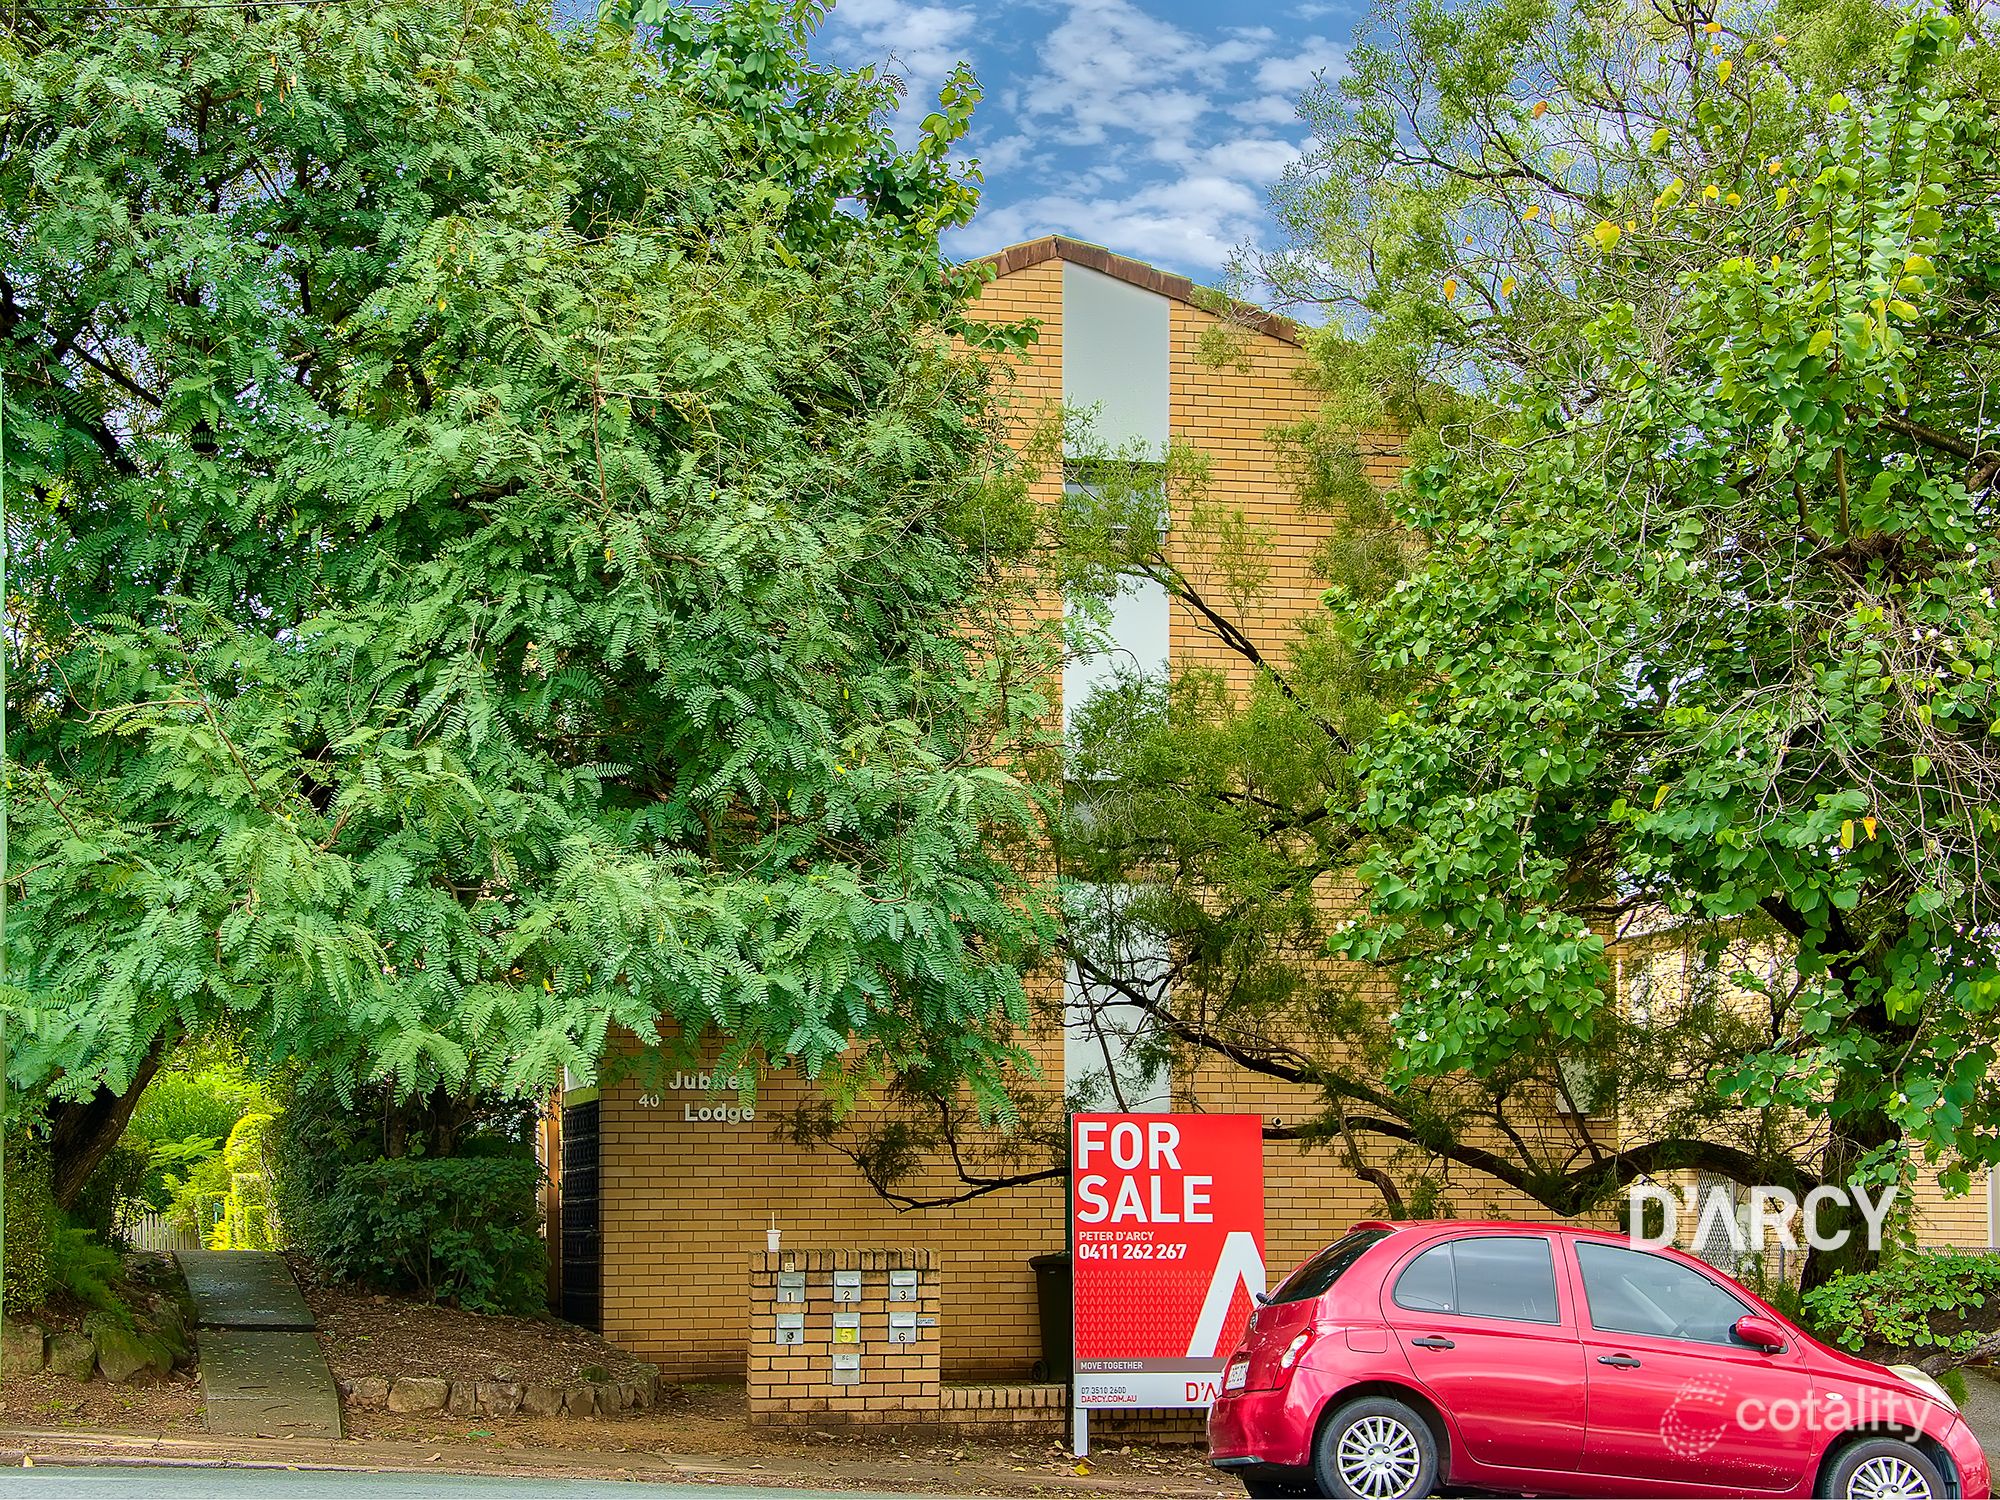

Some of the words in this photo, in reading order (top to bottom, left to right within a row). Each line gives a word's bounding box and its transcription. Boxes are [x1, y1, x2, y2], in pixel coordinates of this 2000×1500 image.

[638, 1093, 660, 1107] 40
[684, 1103, 755, 1125] Lodge
[1078, 1122, 1182, 1170] FOR
[1077, 1175, 1214, 1223] SALE
[1079, 1231, 1114, 1241] PETER
[1115, 1231, 1155, 1241] D'ARCY
[1079, 1243, 1118, 1260] 0411
[1122, 1243, 1154, 1260] 262
[1156, 1243, 1187, 1260] 267
[787, 1292, 793, 1302] 1
[843, 1290, 851, 1301] 2
[899, 1290, 907, 1300] 3
[840, 1328, 853, 1343] 5
[898, 1332, 906, 1342] 6
[1080, 1361, 1102, 1370] MOVE
[1102, 1361, 1144, 1370] TOGETHER
[1081, 1386, 1090, 1395] 07
[1091, 1386, 1108, 1395] 3510
[1185, 1382, 1218, 1402] D'A
[1081, 1395, 1138, 1403] DARCY.COM.AU
